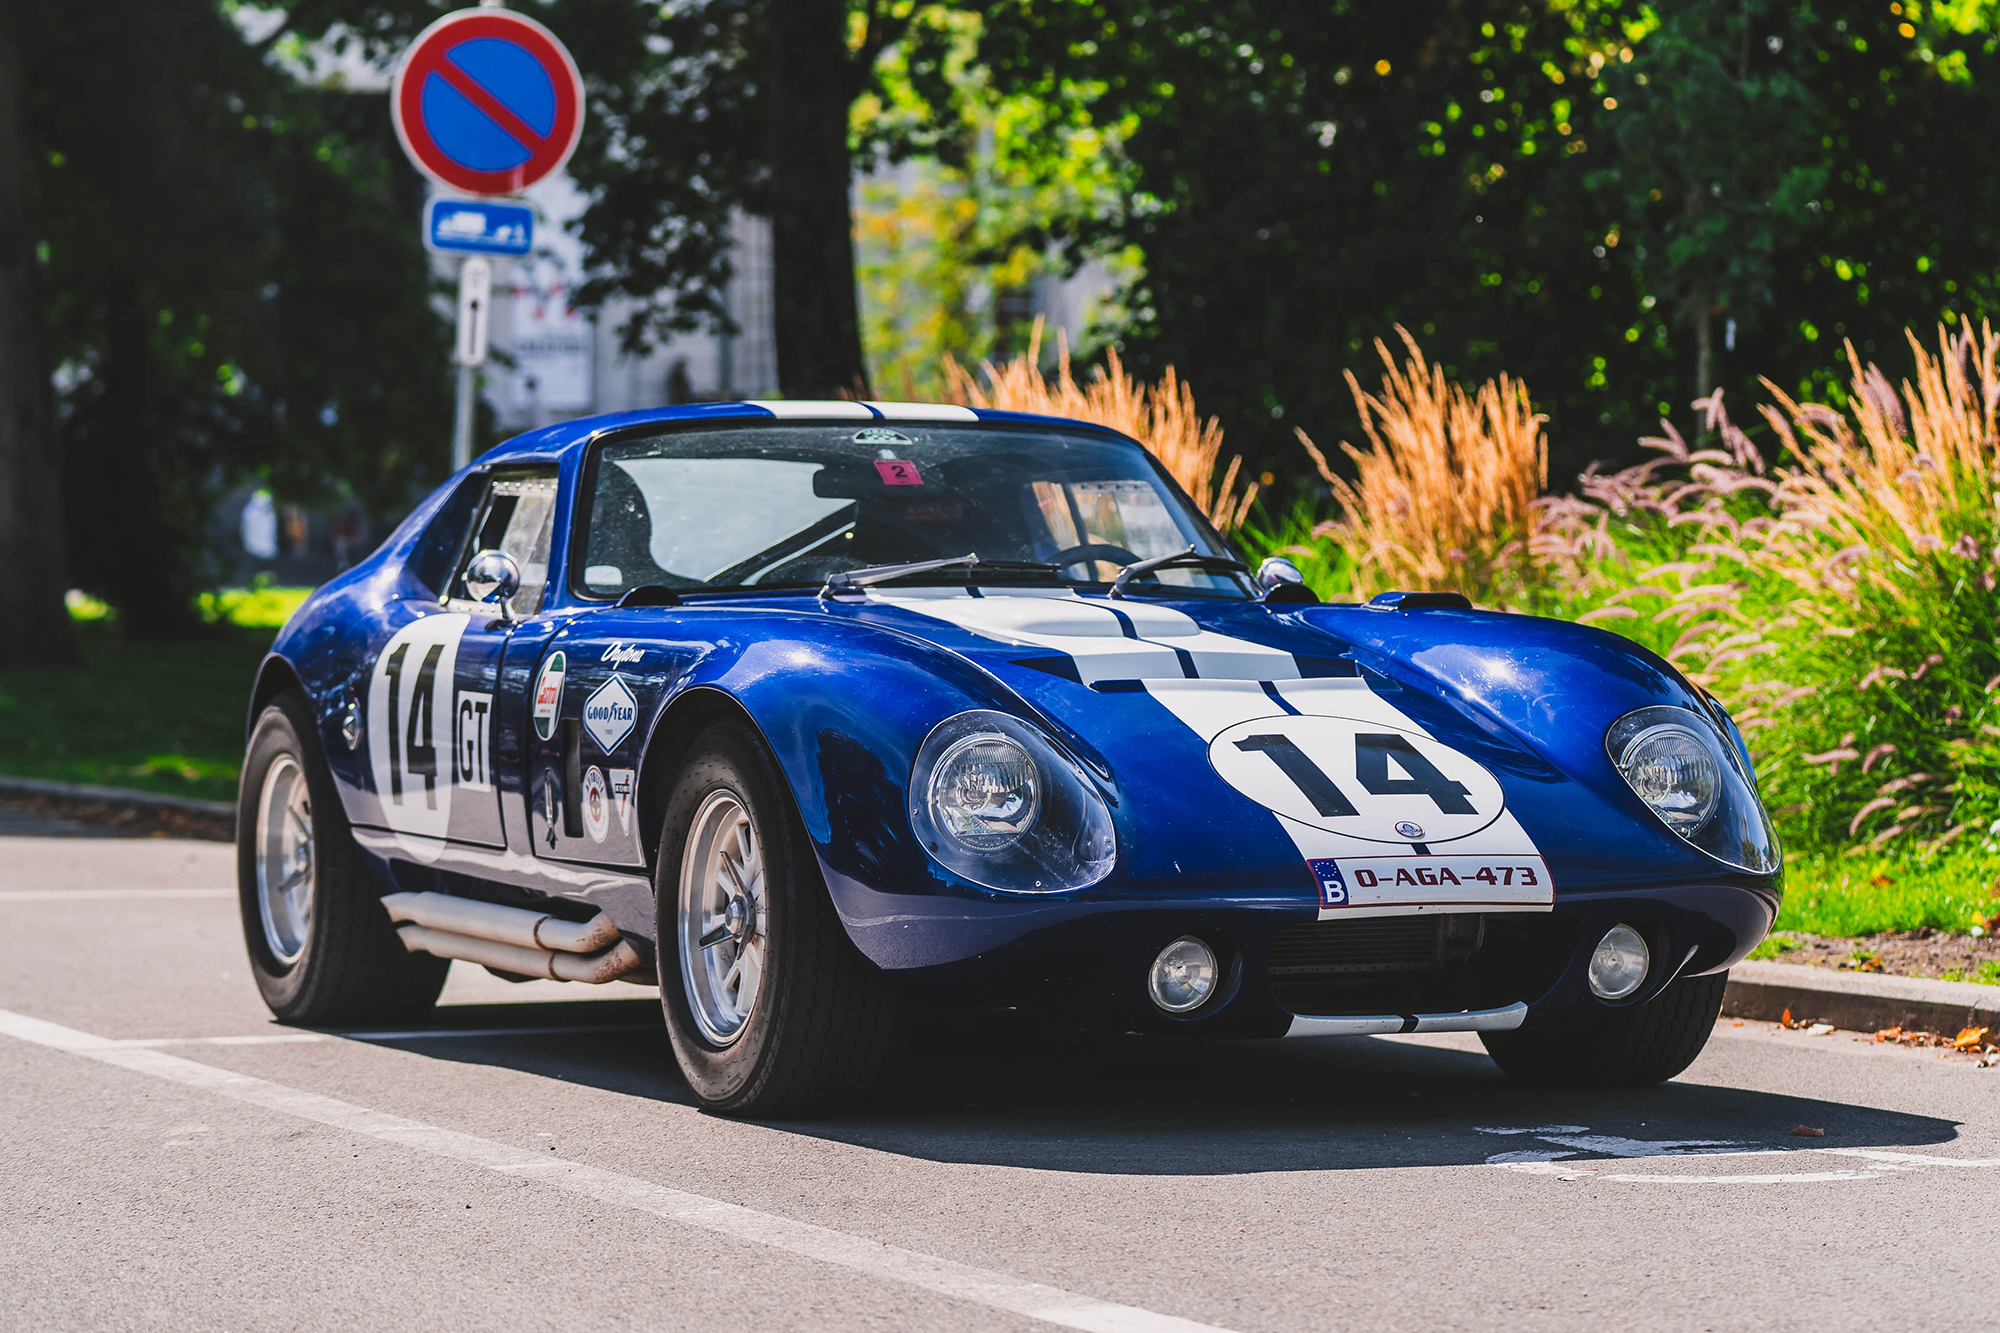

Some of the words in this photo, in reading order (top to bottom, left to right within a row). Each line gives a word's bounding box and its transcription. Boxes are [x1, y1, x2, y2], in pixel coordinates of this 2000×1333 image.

[891, 465, 908, 478] 2
[386, 643, 445, 810] 14
[459, 699, 490, 785] GT
[1232, 733, 1480, 817] 14
[1323, 880, 1345, 903] B
